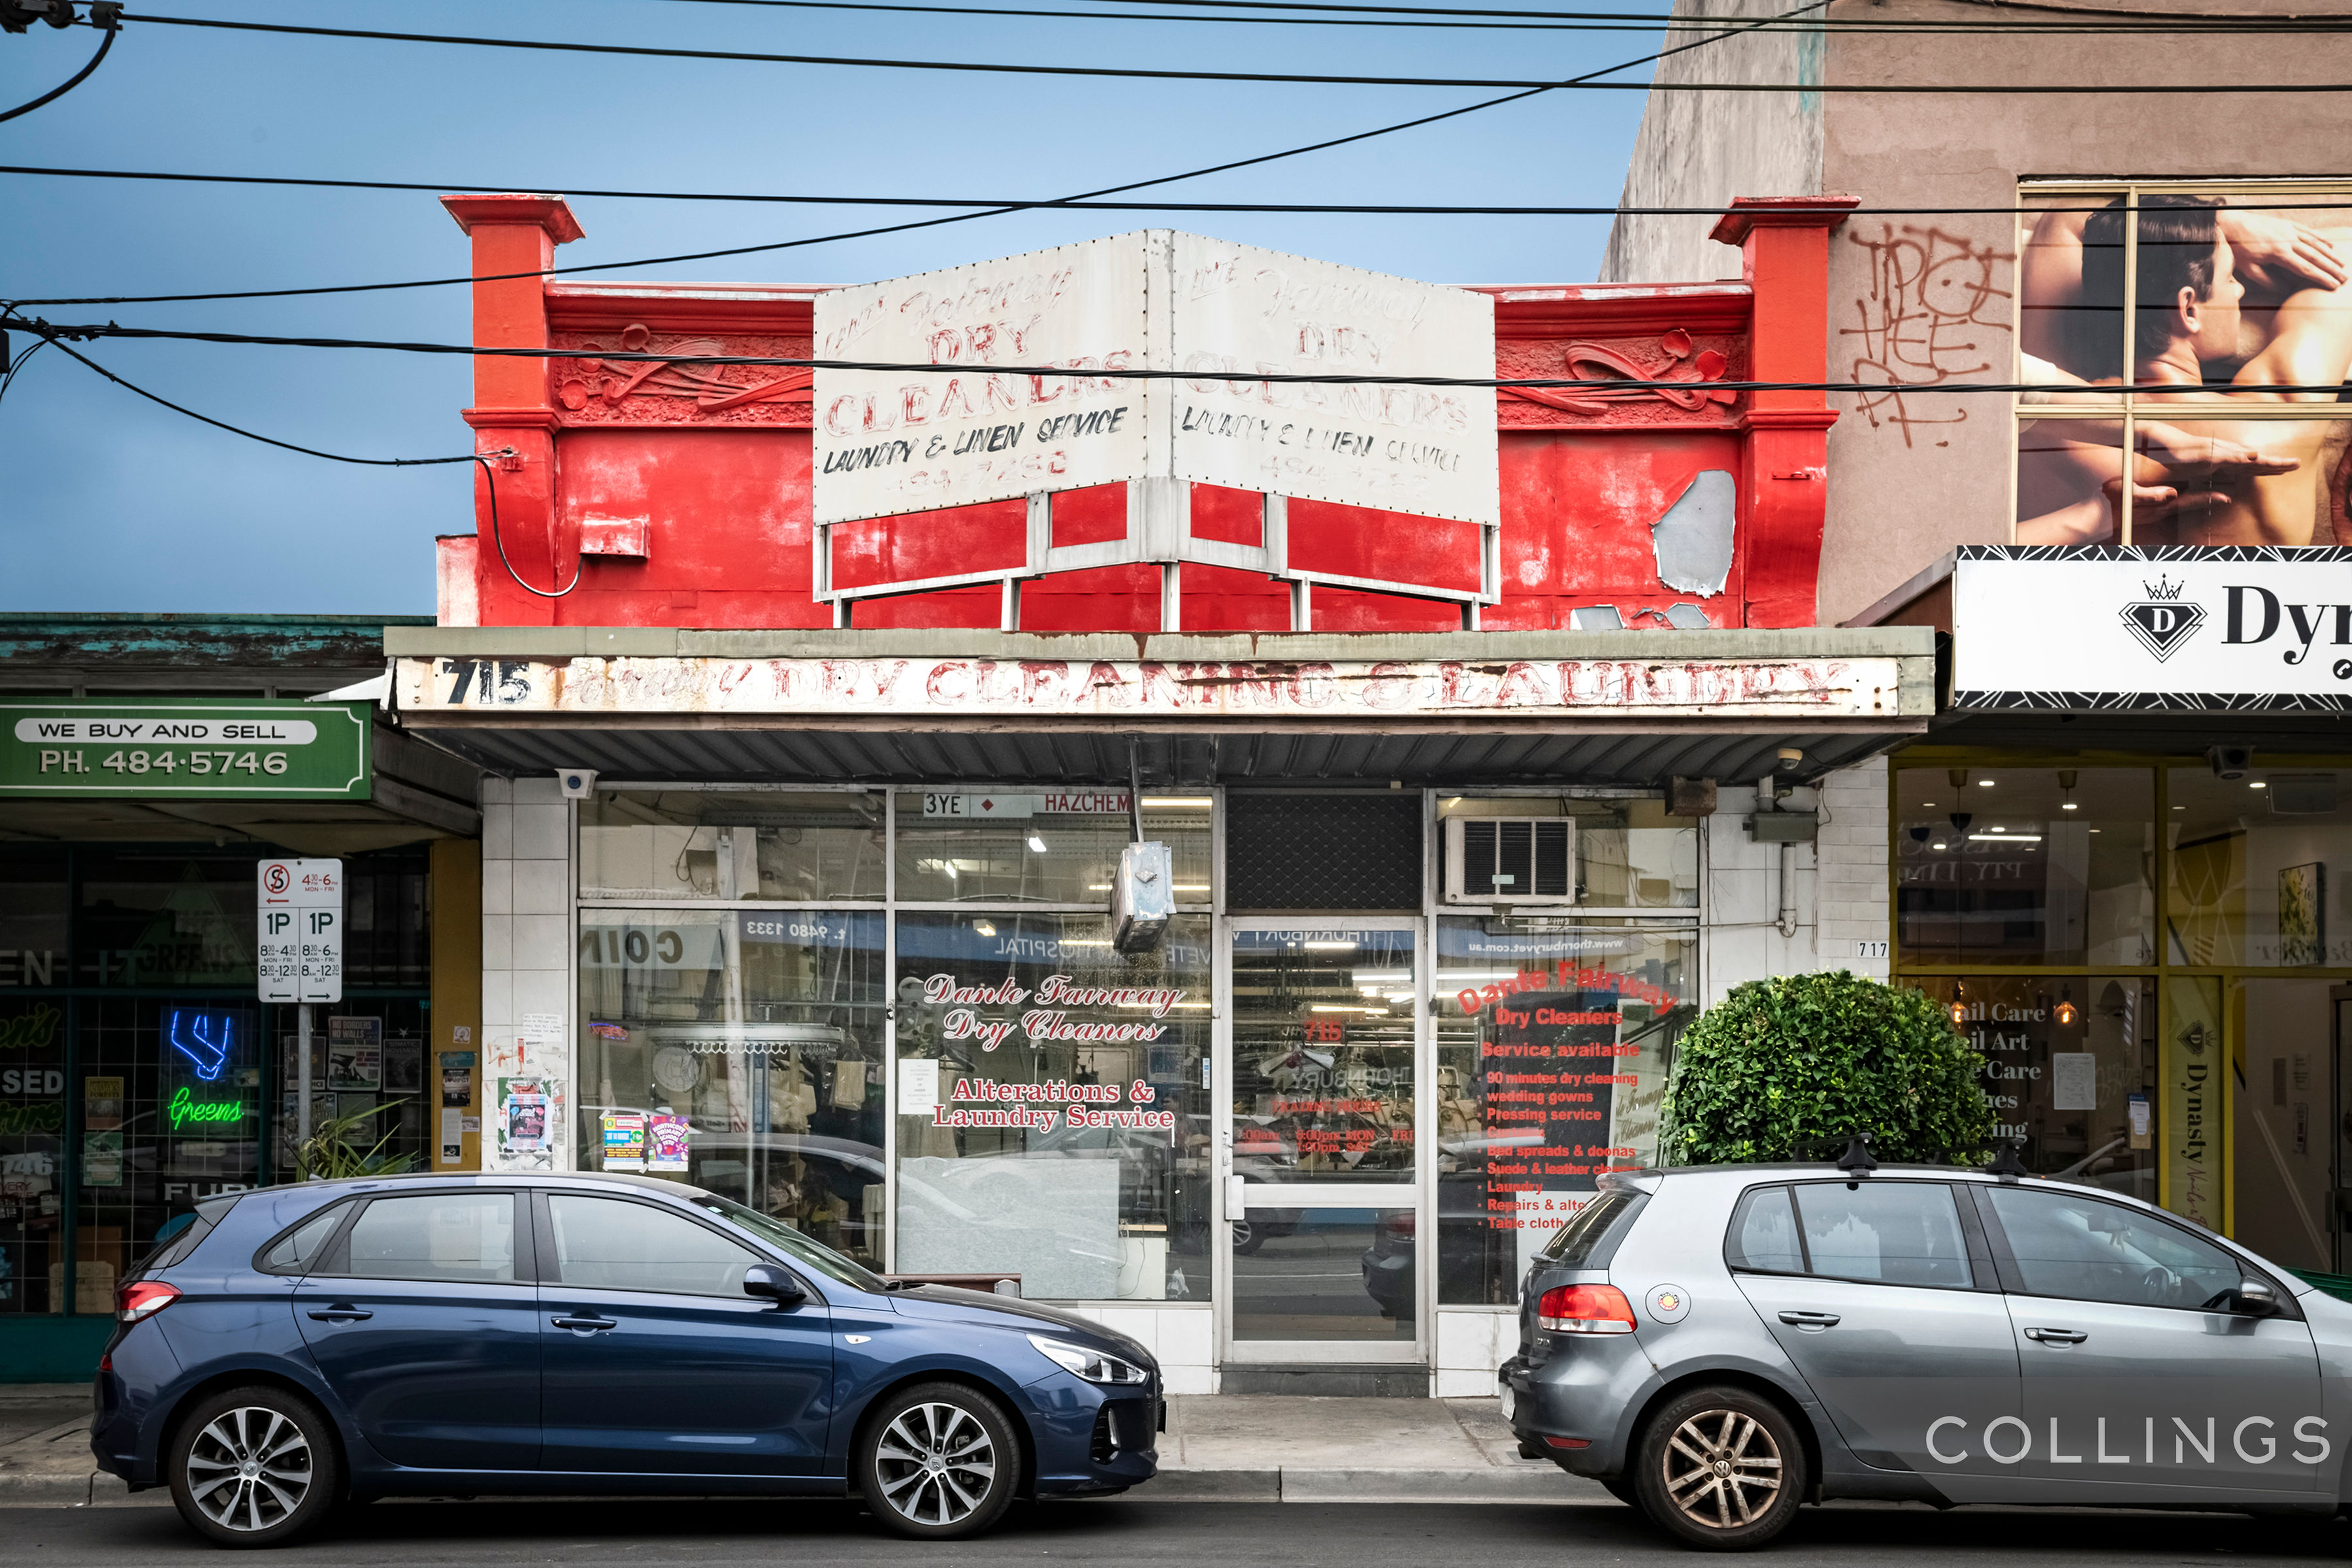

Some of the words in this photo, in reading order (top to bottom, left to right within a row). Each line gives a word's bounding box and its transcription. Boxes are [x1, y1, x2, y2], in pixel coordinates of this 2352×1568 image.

[925, 314, 1042, 365] DRY
[824, 349, 1133, 438] CLEANERS
[823, 438, 918, 474] LAUNDRY
[925, 434, 947, 460] &
[953, 422, 1025, 455] LINEN
[1037, 406, 1128, 444] SERVICE
[442, 661, 531, 705] 715
[771, 659, 909, 707] DRY
[925, 660, 1333, 708] CLEANING
[1439, 660, 1852, 707] LAUNDRY
[38, 723, 76, 738] WE
[88, 724, 143, 738] BUY
[151, 725, 208, 739] AND
[222, 725, 286, 739] SELL
[39, 749, 90, 774] PH.
[925, 794, 961, 815] 3YE
[1045, 794, 1130, 813] HAZCHEM
[267, 912, 291, 935] 1P
[309, 912, 334, 935] 1P
[1859, 942, 1887, 957] 717
[923, 973, 1032, 1005] Dante
[1034, 975, 1186, 1019] Fairway
[1457, 968, 1548, 1015] Dante
[1558, 961, 1679, 1015] Fairway
[1495, 1009, 1530, 1029] Dry
[1535, 1008, 1624, 1025] Cleaners
[1991, 1003, 2046, 1022] Care
[332, 1021, 342, 1029] NO
[342, 1021, 372, 1030] BORDERS
[342, 1030, 365, 1038] WALLS
[943, 1008, 1018, 1053] Dry
[1021, 1009, 1168, 1042] Cleaners
[1303, 1021, 1343, 1042] 715
[1481, 1041, 1552, 1056] Service
[1556, 1041, 1641, 1057] available
[1991, 1032, 2030, 1051] Art
[1486, 1072, 1502, 1084] 90
[1505, 1072, 1557, 1085] minutes
[1560, 1072, 1581, 1087] dry
[1584, 1072, 1639, 1087] cleaning
[1986, 1060, 2042, 1080] Care
[951, 1078, 1121, 1103] Alterations
[1128, 1079, 1156, 1103] &
[1487, 1090, 1544, 1105] wedding
[1548, 1093, 1593, 1105] gowns
[169, 1086, 242, 1130] Greens
[1272, 1101, 1331, 1112] TRADING
[1338, 1101, 1381, 1111] HOURS
[1487, 1108, 1547, 1123] Pressing
[1550, 1109, 1601, 1120] service
[2180, 1063, 2208, 1164] Dynasty
[652, 1122, 686, 1134] NORTHCOTE
[931, 1103, 1060, 1134] Laundry
[1066, 1104, 1175, 1130] Service
[657, 1128, 683, 1137] PRIMARY
[1345, 1130, 1375, 1141] MON
[1392, 1130, 1415, 1141] FRI
[1346, 1141, 1372, 1152] SAT
[1487, 1145, 1514, 1157] Bed
[1517, 1145, 1569, 1159] spreads
[1573, 1145, 1584, 1156] &
[1588, 1145, 1636, 1157] doonas
[1487, 1163, 1527, 1175] Suede
[1531, 1163, 1541, 1175] &
[1544, 1163, 1590, 1175] leather
[163, 1183, 259, 1201] FUR
[1488, 1181, 1543, 1195] Laundry
[1488, 1199, 1539, 1214] Repairs
[1544, 1199, 1554, 1211] &
[1559, 1199, 1586, 1211] alte
[1488, 1217, 1525, 1229] Table
[1529, 1217, 1567, 1229] cloth
